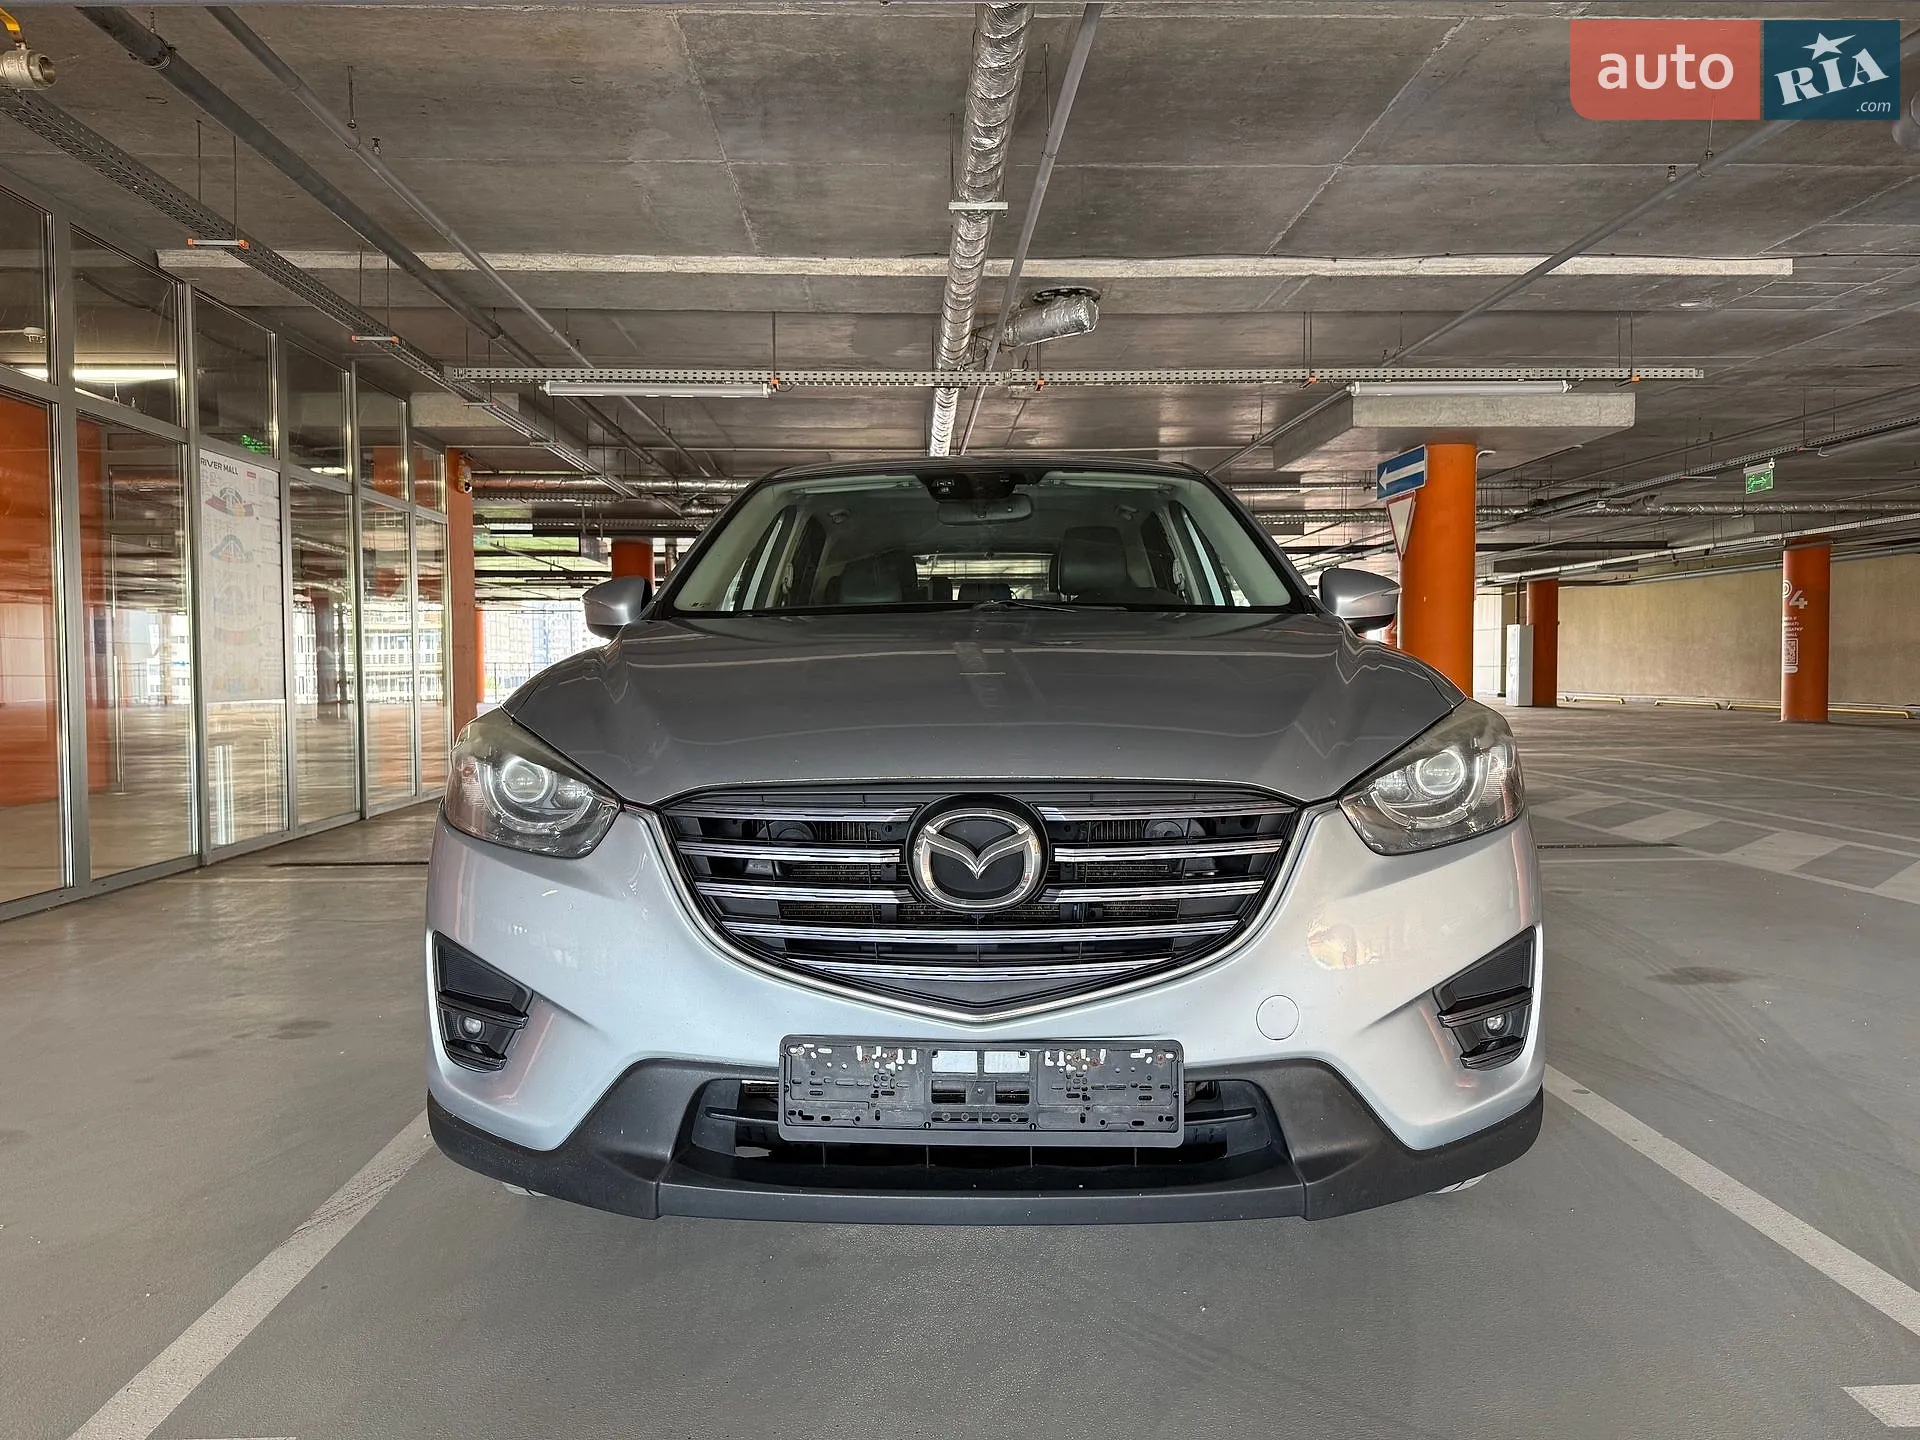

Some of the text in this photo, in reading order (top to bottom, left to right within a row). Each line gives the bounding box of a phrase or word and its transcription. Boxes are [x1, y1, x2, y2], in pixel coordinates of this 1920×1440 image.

[200, 457, 223, 471] RIVER
[223, 464, 239, 475] MALL
[1789, 590, 1808, 609] 4
